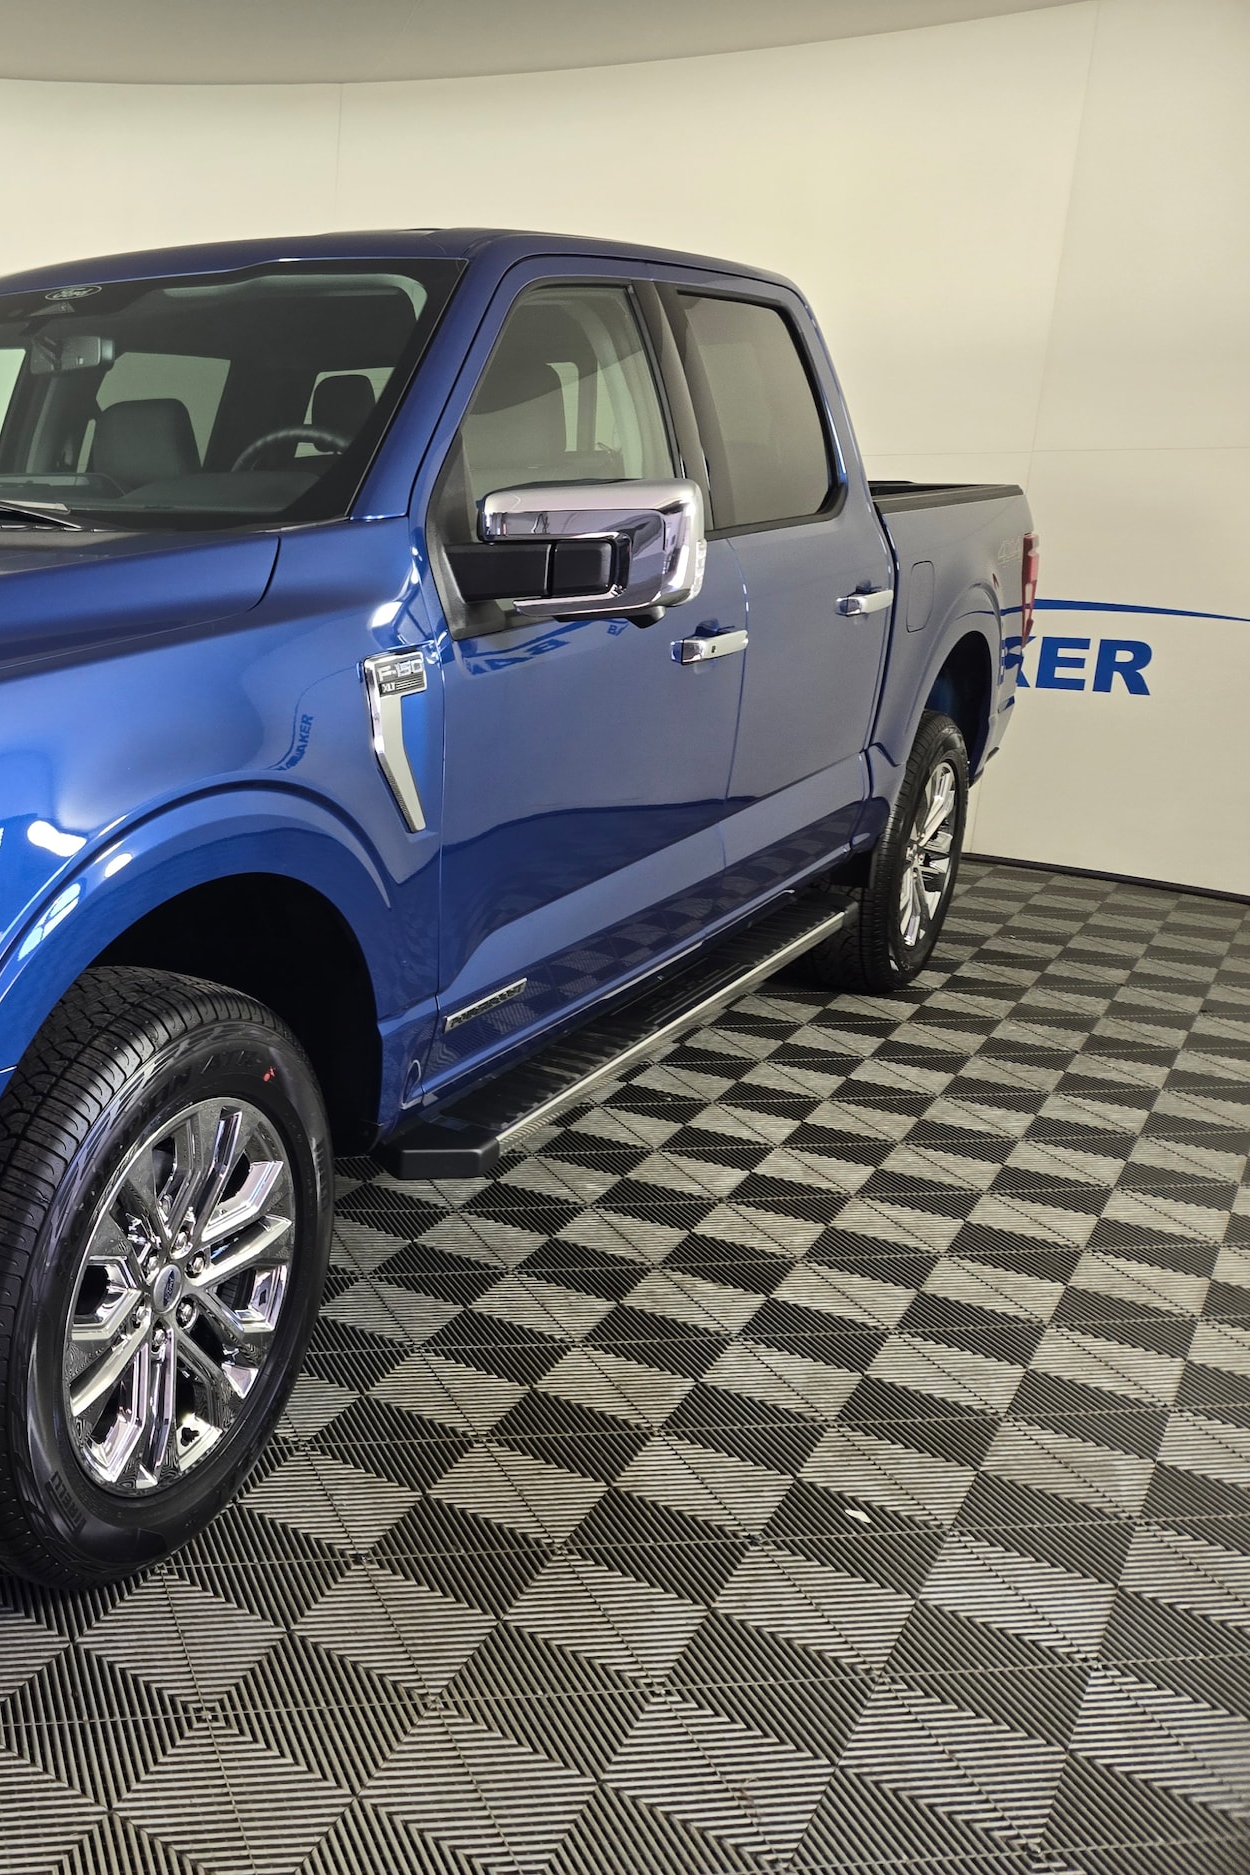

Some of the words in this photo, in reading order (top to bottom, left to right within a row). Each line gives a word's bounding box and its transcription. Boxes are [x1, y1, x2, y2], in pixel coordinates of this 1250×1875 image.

[377, 659, 424, 682] F-150
[381, 681, 396, 693] XLT
[44, 1470, 87, 1535] PIRELLI
